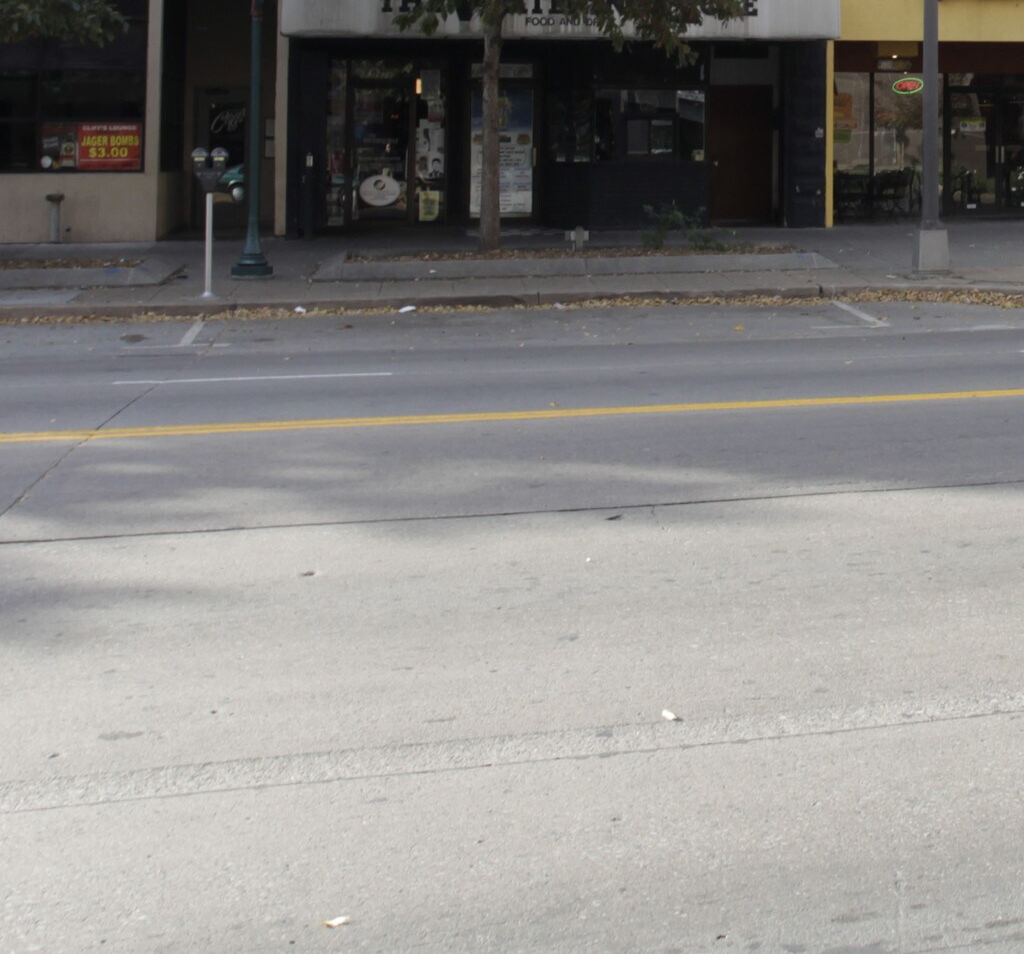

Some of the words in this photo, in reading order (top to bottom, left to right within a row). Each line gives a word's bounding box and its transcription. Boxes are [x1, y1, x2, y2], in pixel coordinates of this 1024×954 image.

[525, 16, 555, 27] FOOD
[560, 17, 580, 26] AND
[81, 135, 108, 146] JAGER
[110, 135, 140, 146] BOMBS
[88, 147, 128, 158] $3.00
